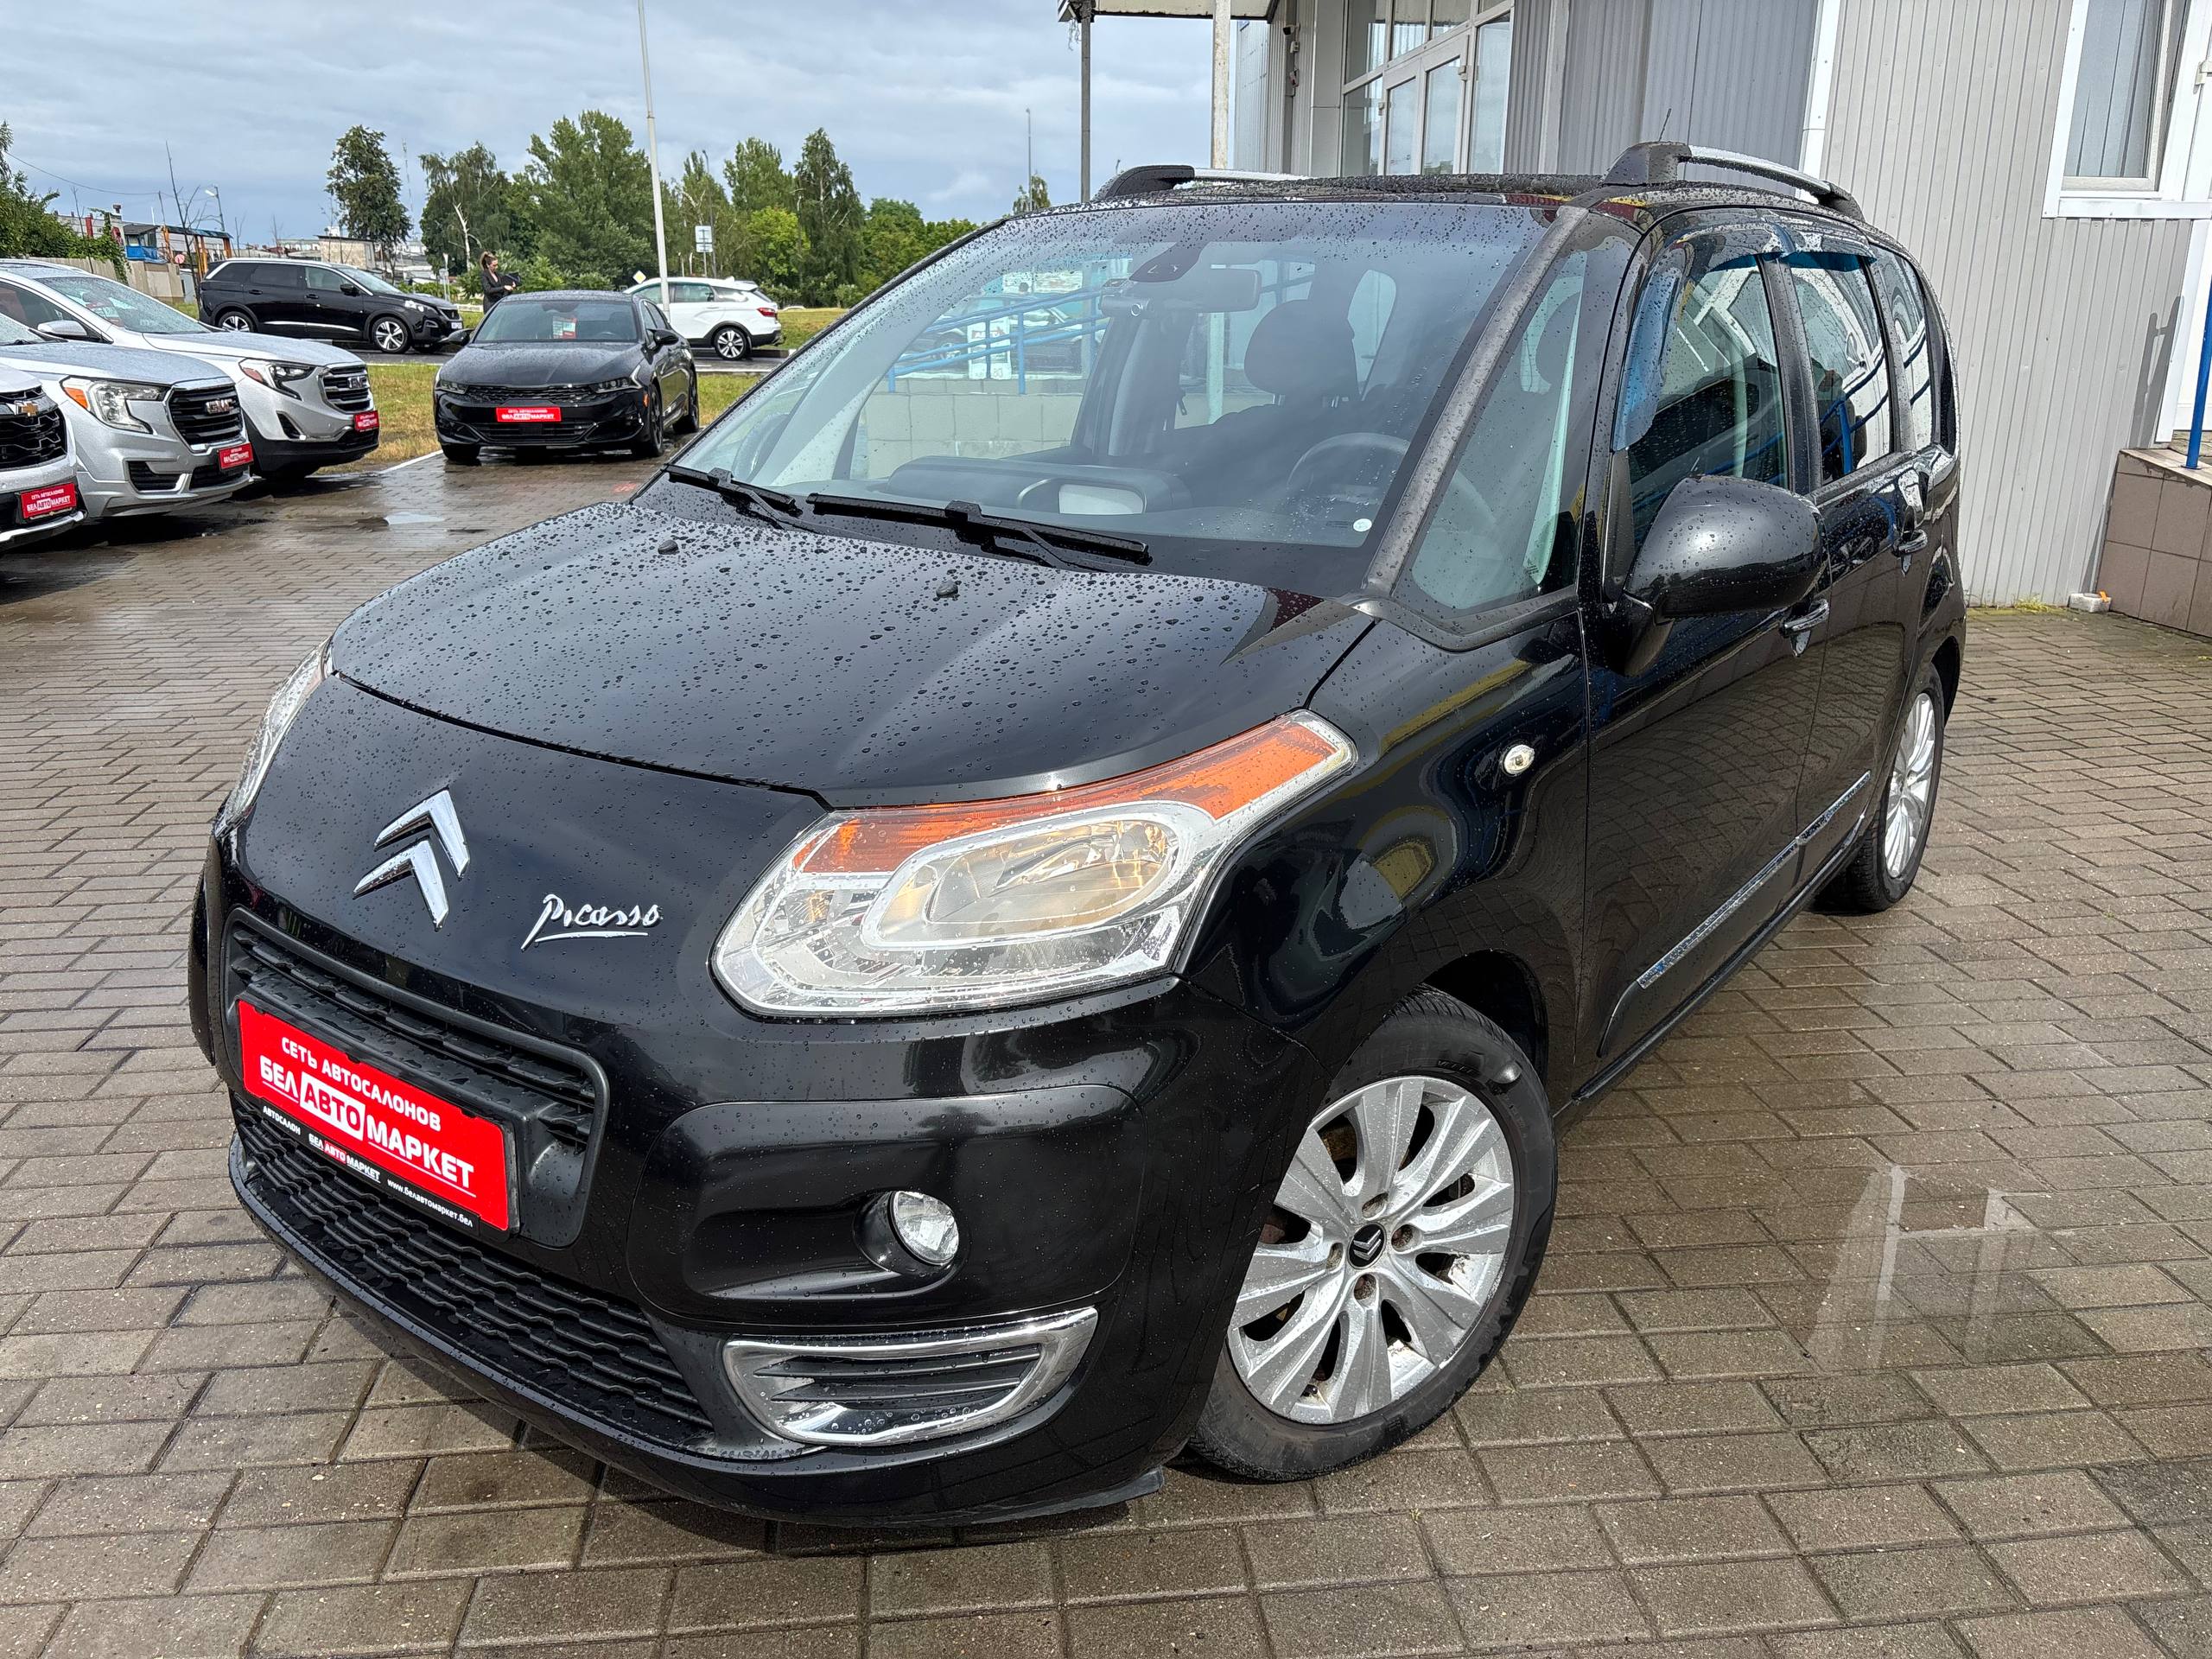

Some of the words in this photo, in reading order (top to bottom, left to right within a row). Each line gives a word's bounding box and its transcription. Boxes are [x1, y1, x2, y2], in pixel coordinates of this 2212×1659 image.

[206, 398, 235, 414] GMC
[521, 893, 660, 950] Picasso
[282, 1037, 318, 1070] СЕТЬ
[321, 1058, 442, 1132] АВТОСАЛОНОВ
[263, 1106, 301, 1135] АВТОСАЛОН
[387, 1179, 474, 1228] www.белавтомаркет.бел
